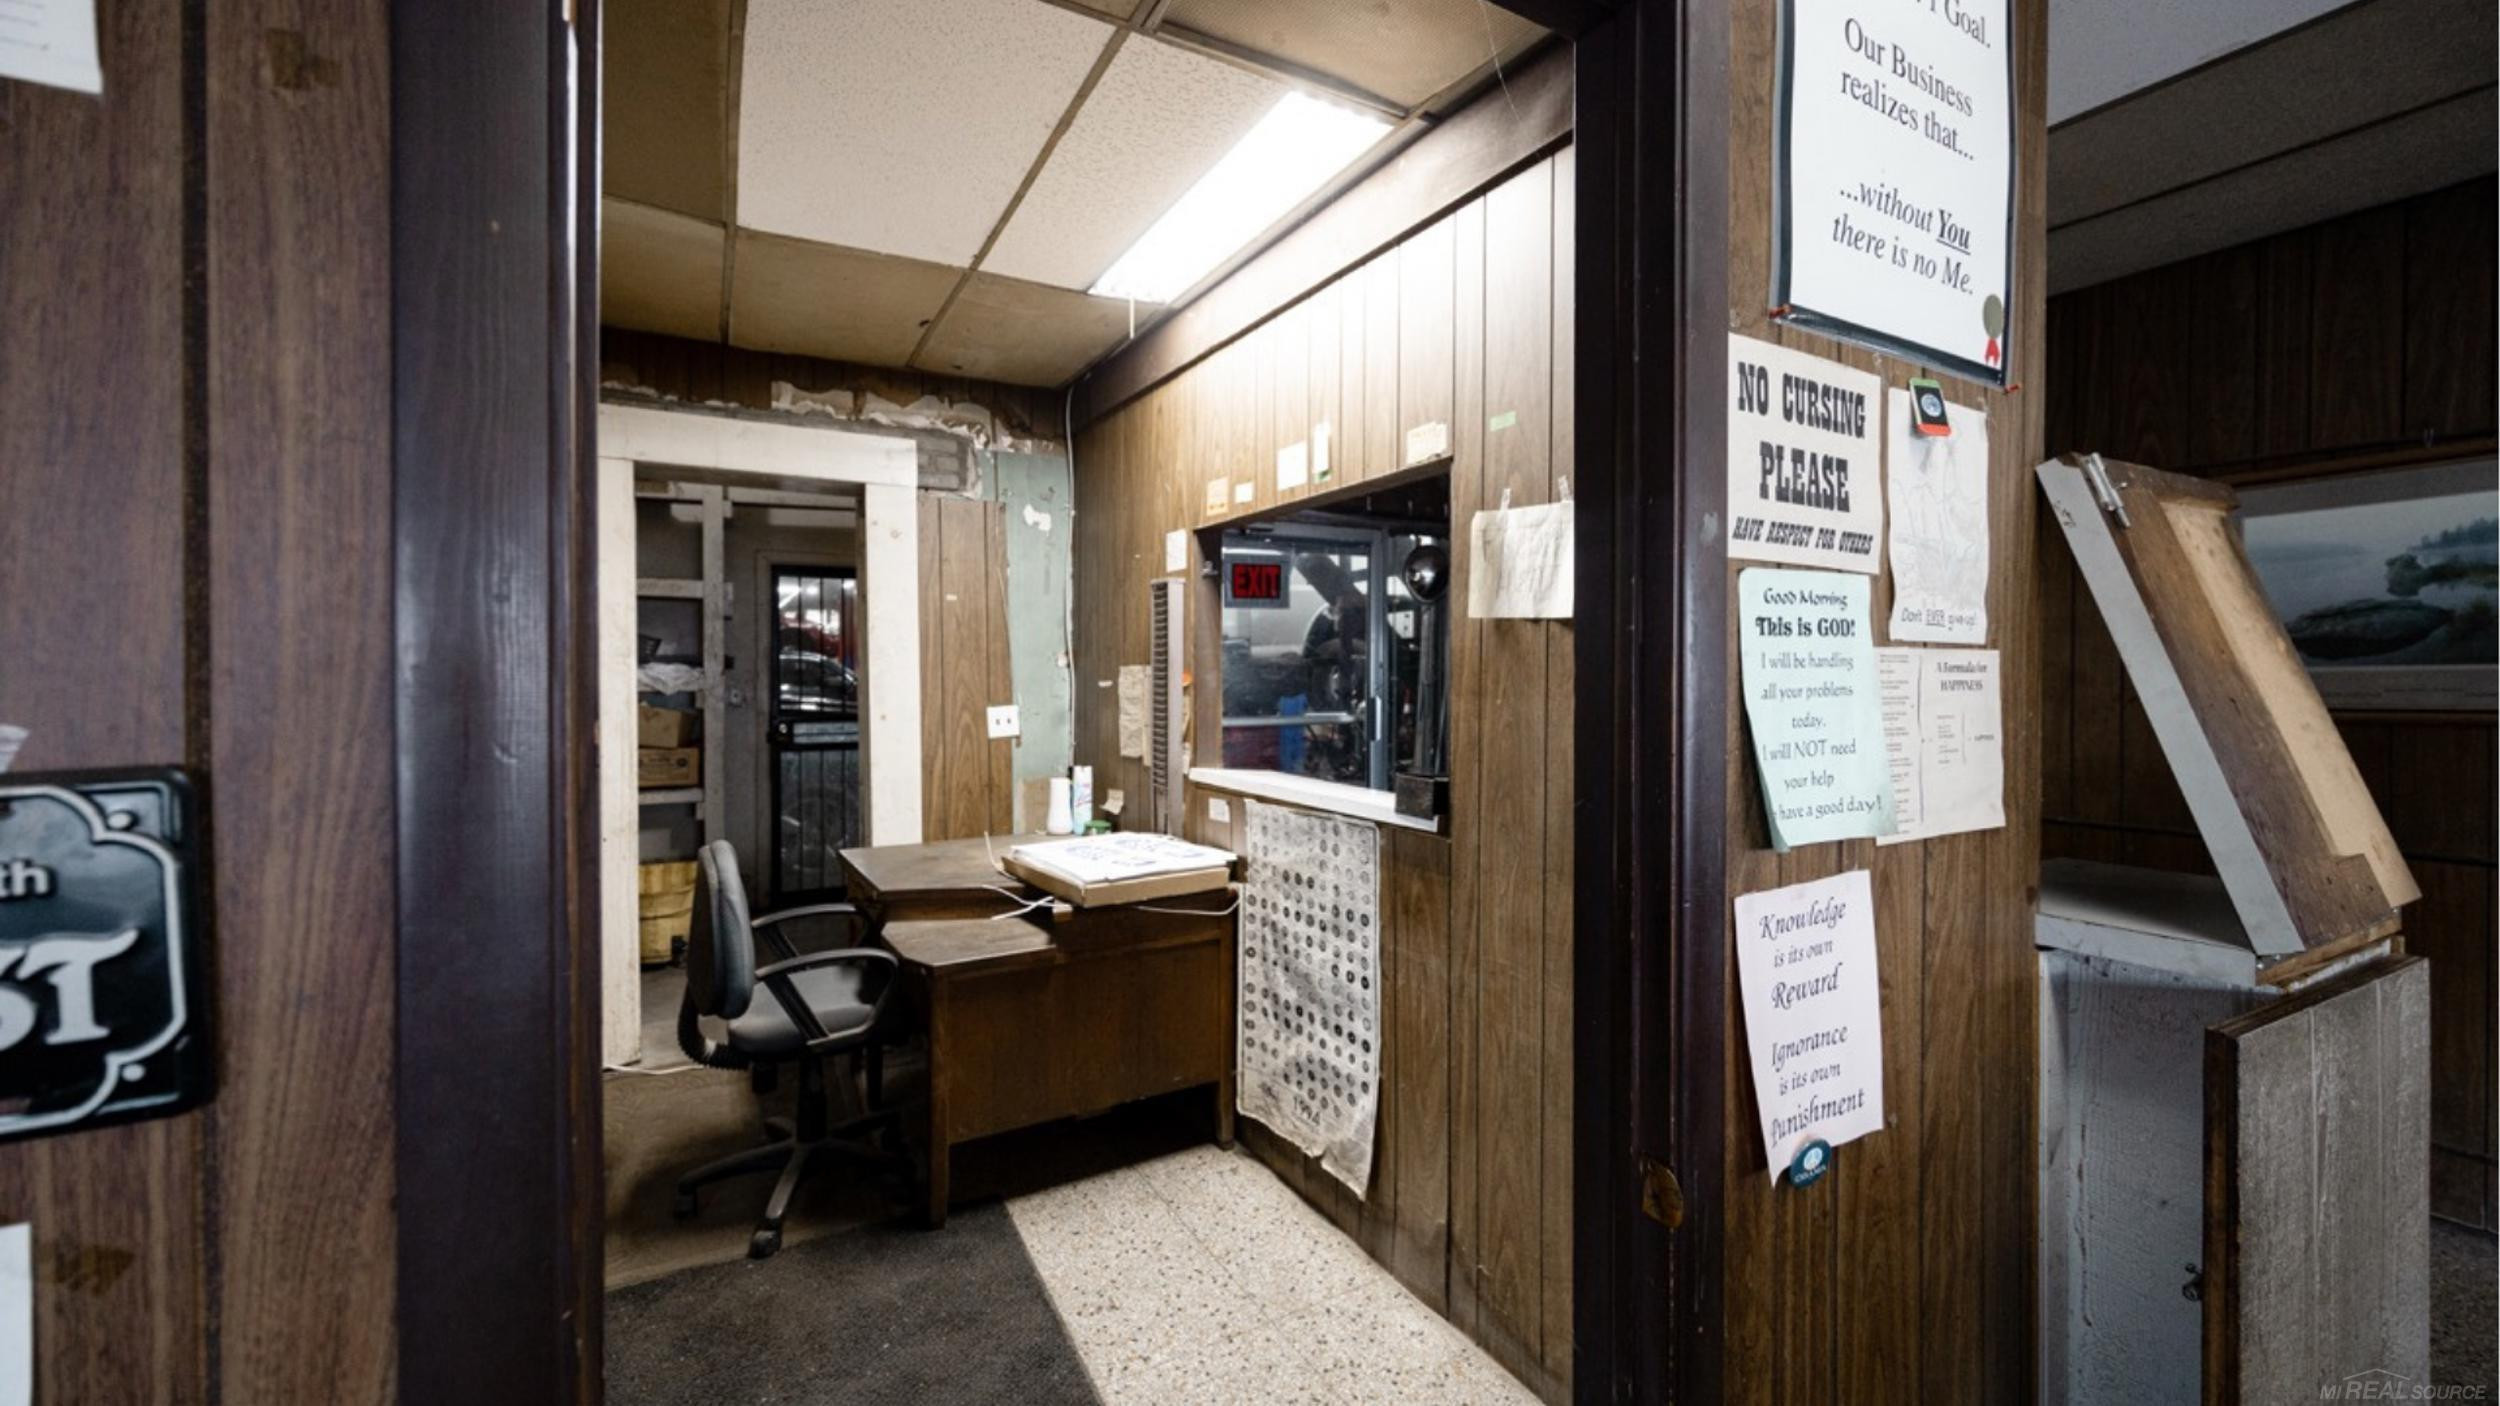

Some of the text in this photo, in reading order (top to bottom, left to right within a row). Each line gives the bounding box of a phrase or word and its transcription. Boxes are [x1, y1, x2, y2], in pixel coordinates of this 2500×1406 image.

[1944, 0, 1991, 48] Goal.
[1844, 17, 1974, 117] Our Business
[1841, 71, 1975, 161] realizes that...
[1840, 182, 1972, 256] ...without You
[1833, 213, 1974, 295] there is no Me.
[1737, 361, 1866, 439] NO CURSING
[1759, 440, 1850, 513] PLEASE
[1732, 516, 1874, 555] HAVE RESPECT FOR OTHERS
[1235, 564, 1280, 596] EXIT
[1763, 587, 1848, 611] Good Morning
[1755, 616, 1856, 638] This is GOD!
[1925, 607, 1947, 627] EVER
[1761, 651, 1854, 671] I will be handling
[1761, 681, 1854, 702] all your problems
[1791, 712, 1826, 731] today.
[1762, 738, 1857, 761] I will NOT need
[1783, 769, 1835, 793] your help
[1806, 805, 1814, 818] a
[1815, 797, 1844, 819] good
[1847, 794, 1883, 814] day!
[1759, 896, 1846, 940] Knowledge
[1774, 940, 1833, 968] is its own
[1771, 961, 1843, 1010] Reward
[1771, 1026, 1848, 1073] Ignorance
[1779, 1063, 1841, 1096] is its own
